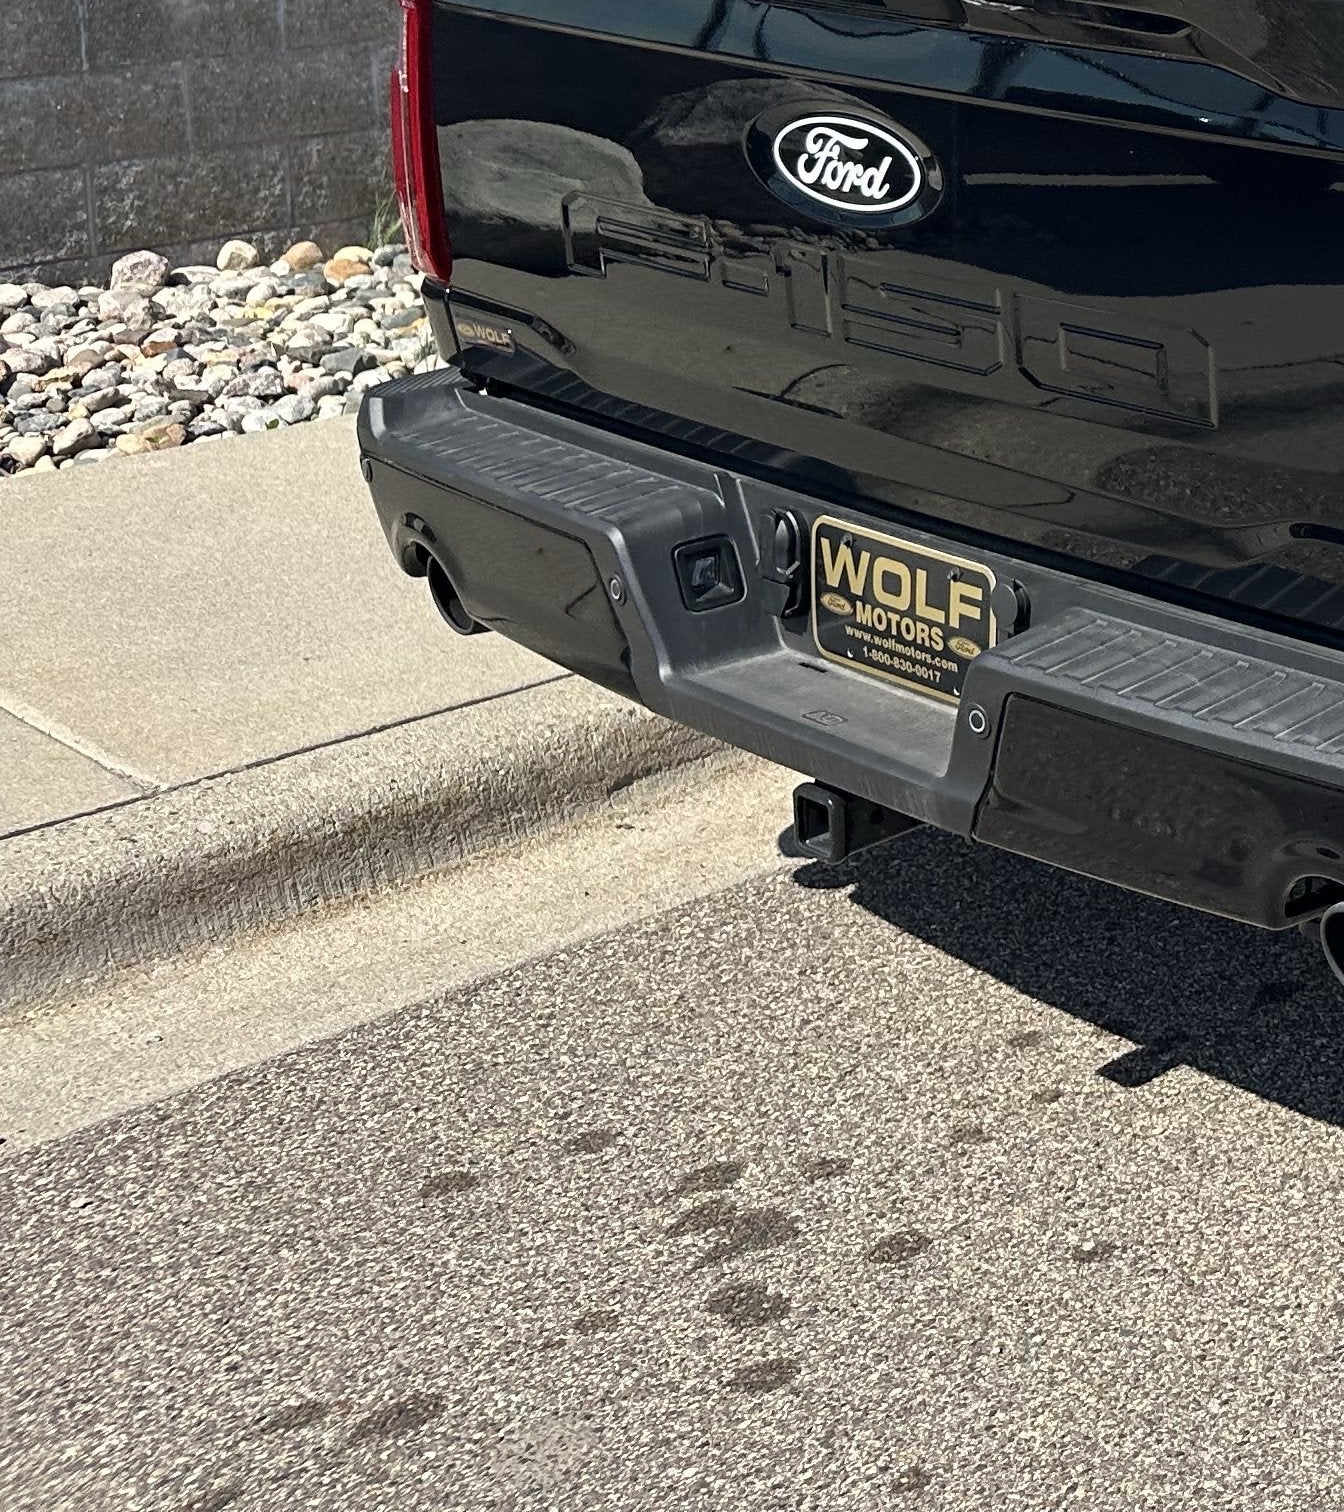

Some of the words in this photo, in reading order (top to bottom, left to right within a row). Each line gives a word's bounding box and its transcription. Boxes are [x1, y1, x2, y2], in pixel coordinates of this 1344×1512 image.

[797, 126, 892, 199] Ford
[472, 323, 511, 344] WOLF
[561, 190, 1219, 429] F-150
[820, 537, 983, 629] WOLF
[845, 624, 958, 673] www.wolfmotors.com
[855, 600, 944, 652] MOTORS
